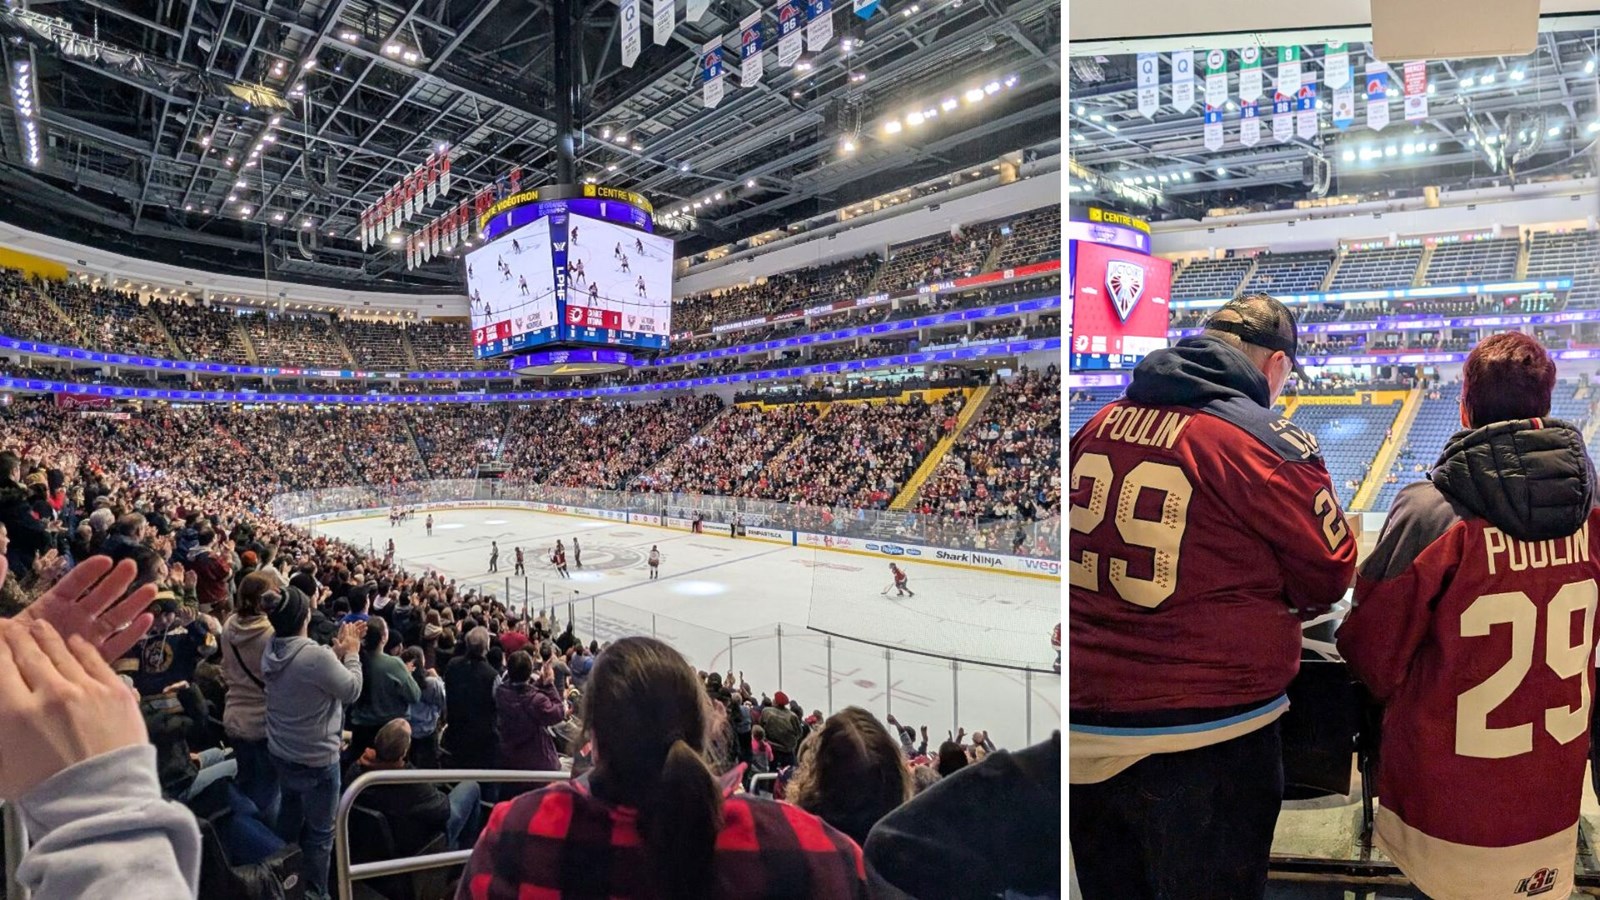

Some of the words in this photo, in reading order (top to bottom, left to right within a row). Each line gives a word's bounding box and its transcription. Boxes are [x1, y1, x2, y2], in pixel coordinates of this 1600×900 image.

[816, 1, 823, 14] 3
[783, 17, 797, 34] 26
[746, 42, 757, 57] 16
[1142, 60, 1152, 74] Q
[1178, 59, 1188, 73] Q
[1277, 102, 1289, 113] 26
[1304, 99, 1310, 109] 3
[1245, 108, 1254, 118] 16
[598, 187, 627, 200] CENTRE
[1104, 212, 1132, 225] CENTRE
[556, 267, 566, 301] LPHF
[1096, 406, 1190, 449] POULIN
[1070, 453, 1193, 608] 29
[1483, 519, 1590, 575] POULIN
[936, 550, 970, 562] Shark
[972, 553, 1003, 567] NINJA
[1455, 578, 1598, 759] 29
